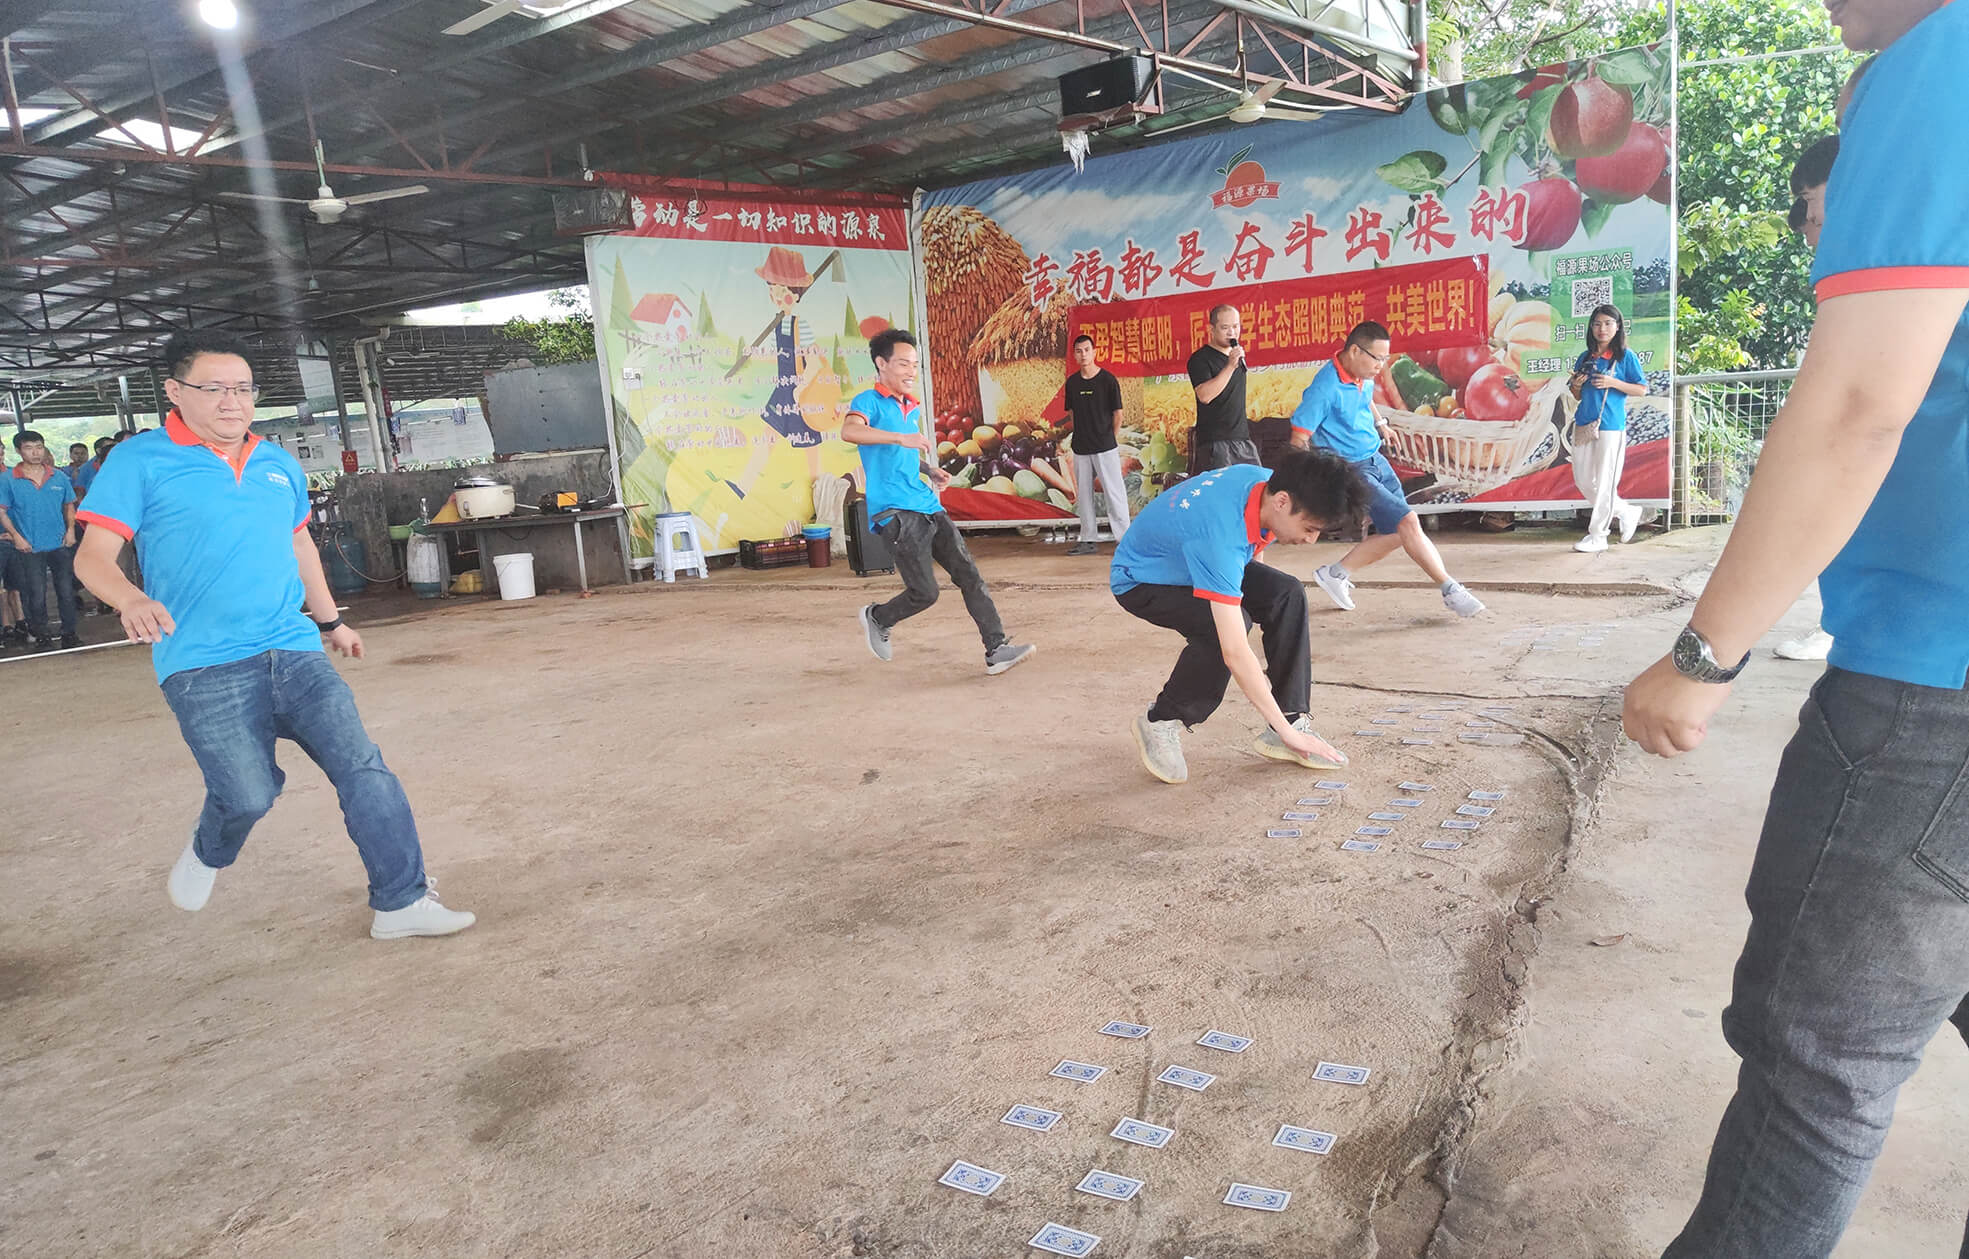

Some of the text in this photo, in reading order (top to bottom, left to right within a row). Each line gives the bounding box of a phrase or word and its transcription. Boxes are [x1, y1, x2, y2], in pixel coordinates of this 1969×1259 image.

[1024, 186, 1527, 304] 幸福都是奋斗出来的
[1556, 252, 1632, 276] 福源果场公众号
[1527, 358, 1561, 373] 王经理
